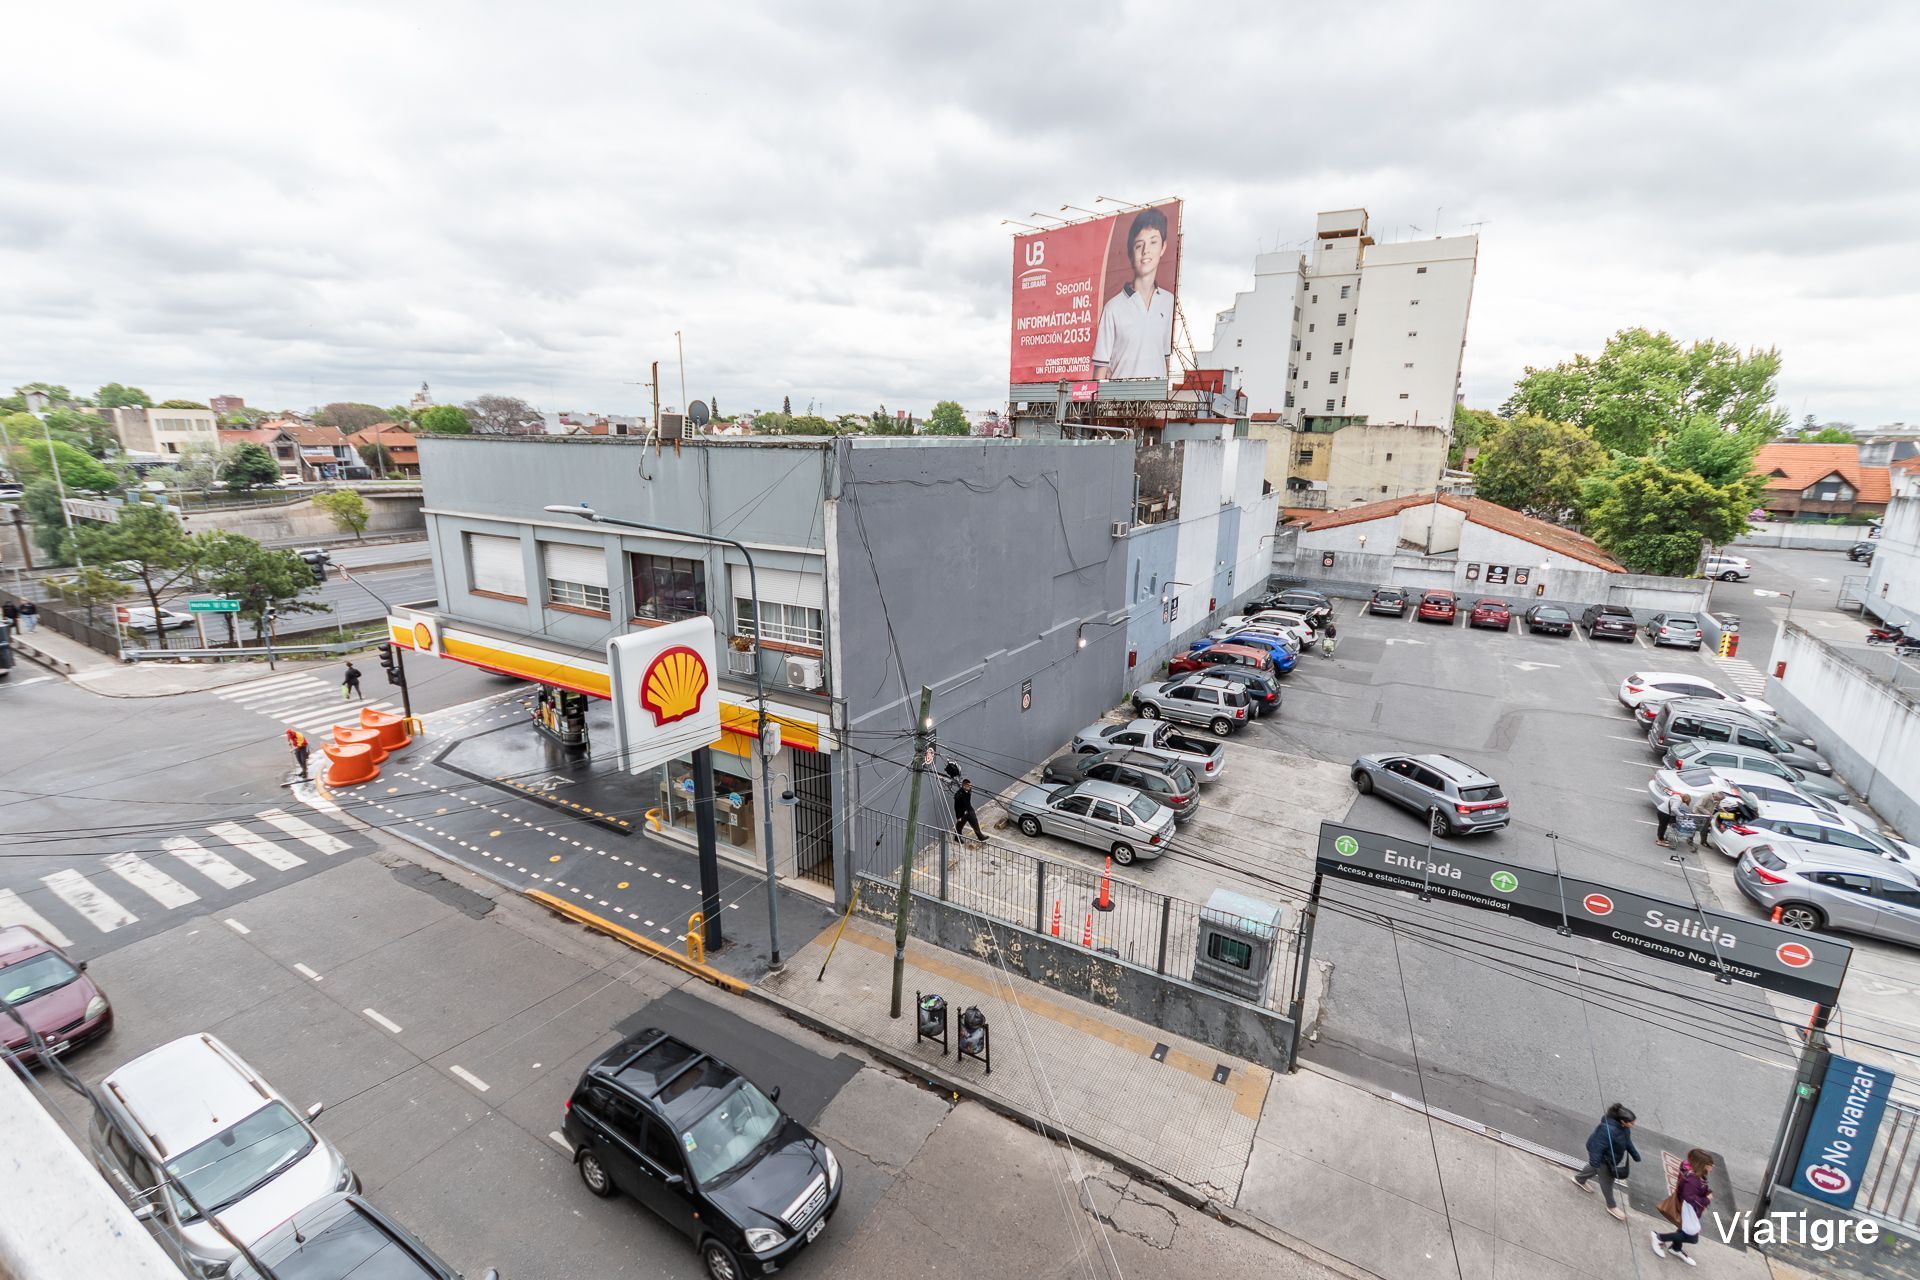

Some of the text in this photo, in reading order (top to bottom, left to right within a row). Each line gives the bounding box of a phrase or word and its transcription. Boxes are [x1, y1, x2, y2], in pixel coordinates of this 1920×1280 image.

[1025, 240, 1045, 267] UB
[1055, 277, 1093, 296] Second,
[1072, 294, 1092, 310] ING.
[1016, 310, 1092, 331] INFORMÁTICA-IA
[1020, 327, 1091, 347] PROMOCIÓN 2033
[1035, 364, 1090, 375] UN FUTURO JUNTOS
[1045, 355, 1091, 367] CONSTRUYAMOS
[1384, 849, 1462, 880] Entrada
[1337, 864, 1367, 876] Acceso
[1375, 874, 1446, 894] estacionamento
[1447, 889, 1511, 911] ¡Bienvenidos!
[1643, 909, 1737, 949] Salida
[1612, 930, 1685, 958] Contramano
[1688, 951, 1706, 964] No
[1821, 1065, 1877, 1166] No avanzar
